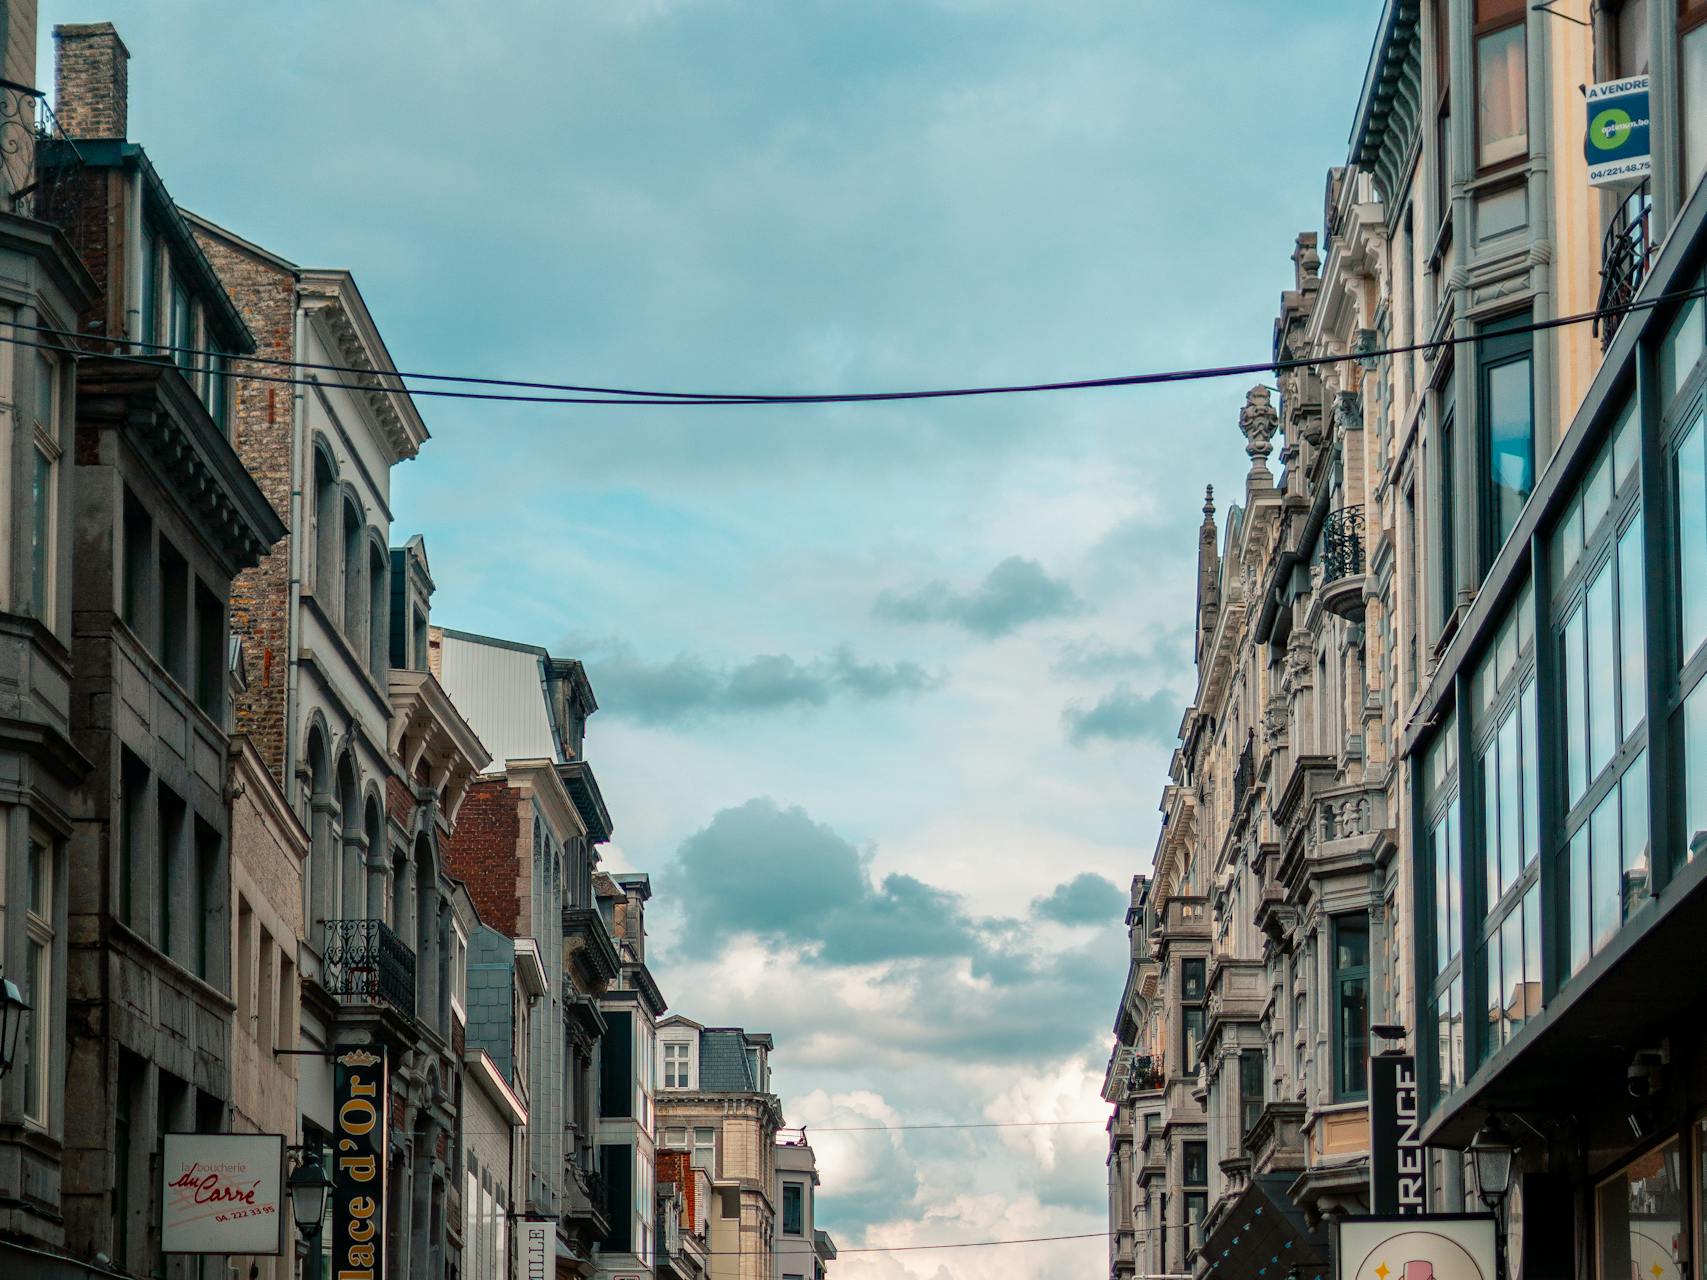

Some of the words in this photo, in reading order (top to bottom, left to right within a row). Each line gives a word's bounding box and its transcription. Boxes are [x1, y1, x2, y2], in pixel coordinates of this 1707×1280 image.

[1589, 90, 1598, 98] A
[1600, 78, 1649, 96] VENDRE
[338, 1074, 377, 1183] d'Or
[1396, 1064, 1423, 1214] RENCE
[197, 1162, 247, 1173] boucherie
[195, 1174, 261, 1205] Carré
[250, 1207, 262, 1217] 33
